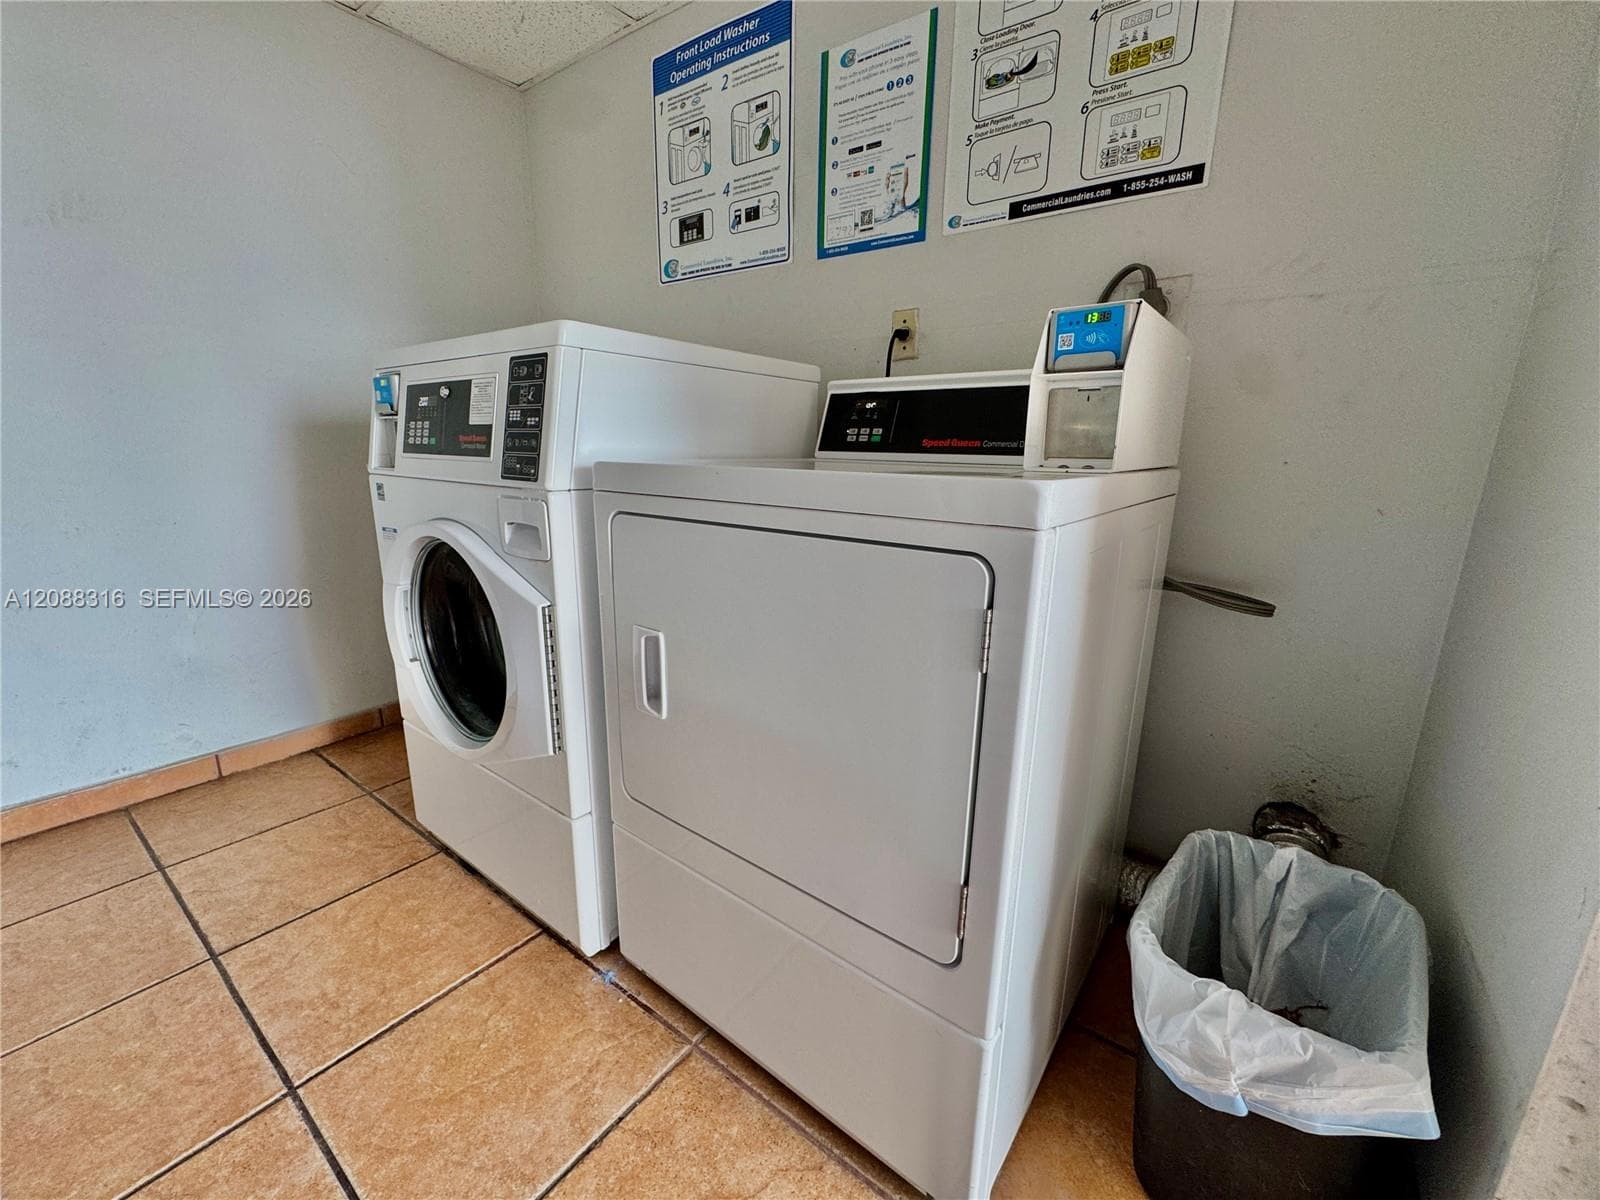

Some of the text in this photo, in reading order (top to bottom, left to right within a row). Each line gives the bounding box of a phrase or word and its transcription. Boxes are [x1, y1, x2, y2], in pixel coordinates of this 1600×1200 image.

[1090, 9, 1098, 22] 4
[676, 18, 760, 64] Front Load Washer
[980, 35, 995, 44] Close
[995, 26, 1019, 40] Loading
[670, 57, 711, 84] Operating
[713, 32, 770, 64] Instructions
[971, 48, 978, 61] 3
[721, 74, 729, 92] 2
[1092, 85, 1109, 96] Press
[660, 102, 664, 116] 1
[1081, 101, 1090, 115] 6
[975, 121, 989, 130] Make
[965, 134, 973, 147] 5
[723, 183, 730, 197] 4
[1022, 171, 1193, 212] CommercialLaundries.com 1-855-254-WASH
[662, 201, 668, 215] 3
[1087, 312, 1099, 323] 13
[922, 438, 950, 448] Speed
[951, 438, 981, 448] Queen
[983, 440, 1018, 448] Commercial
